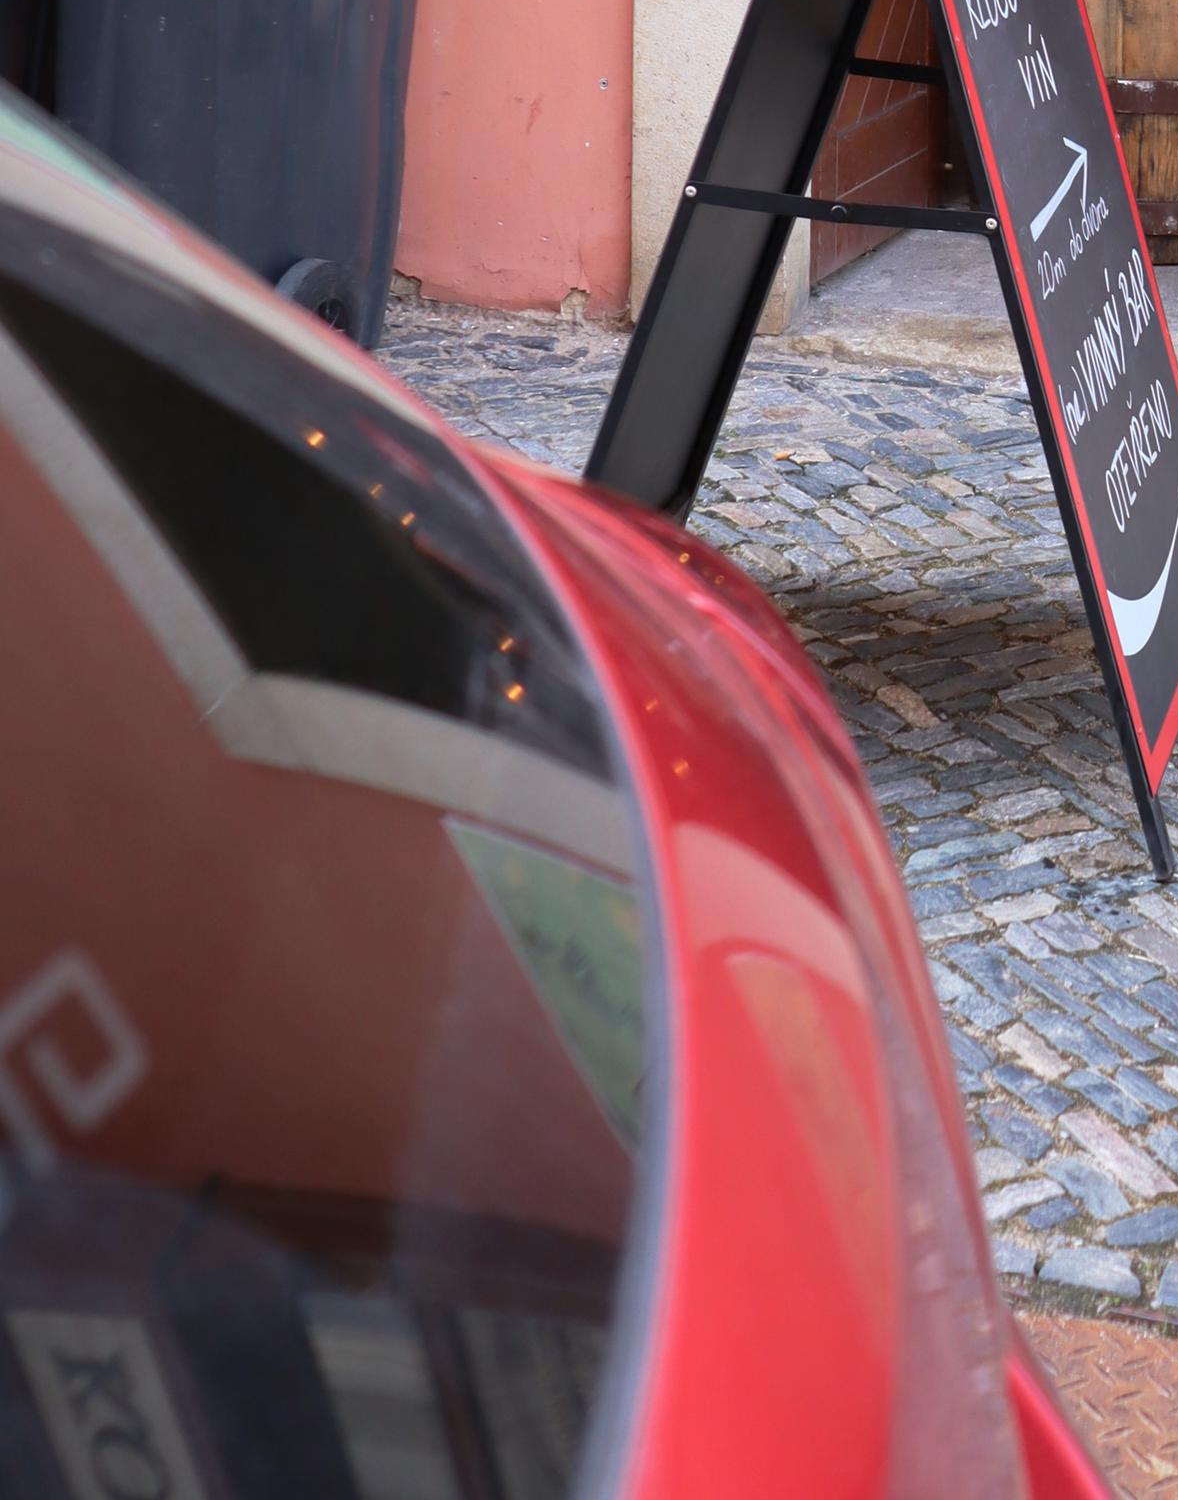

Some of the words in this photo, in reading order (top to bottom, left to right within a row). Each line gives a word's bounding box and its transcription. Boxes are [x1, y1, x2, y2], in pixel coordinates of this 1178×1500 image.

[1017, 23, 1058, 109] VÍN
[1037, 250, 1067, 301] 20m
[1068, 217, 1084, 261] do
[1080, 195, 1110, 242] dvora
[1118, 248, 1155, 348] BAR
[1105, 379, 1173, 533] OTEVŘENO
